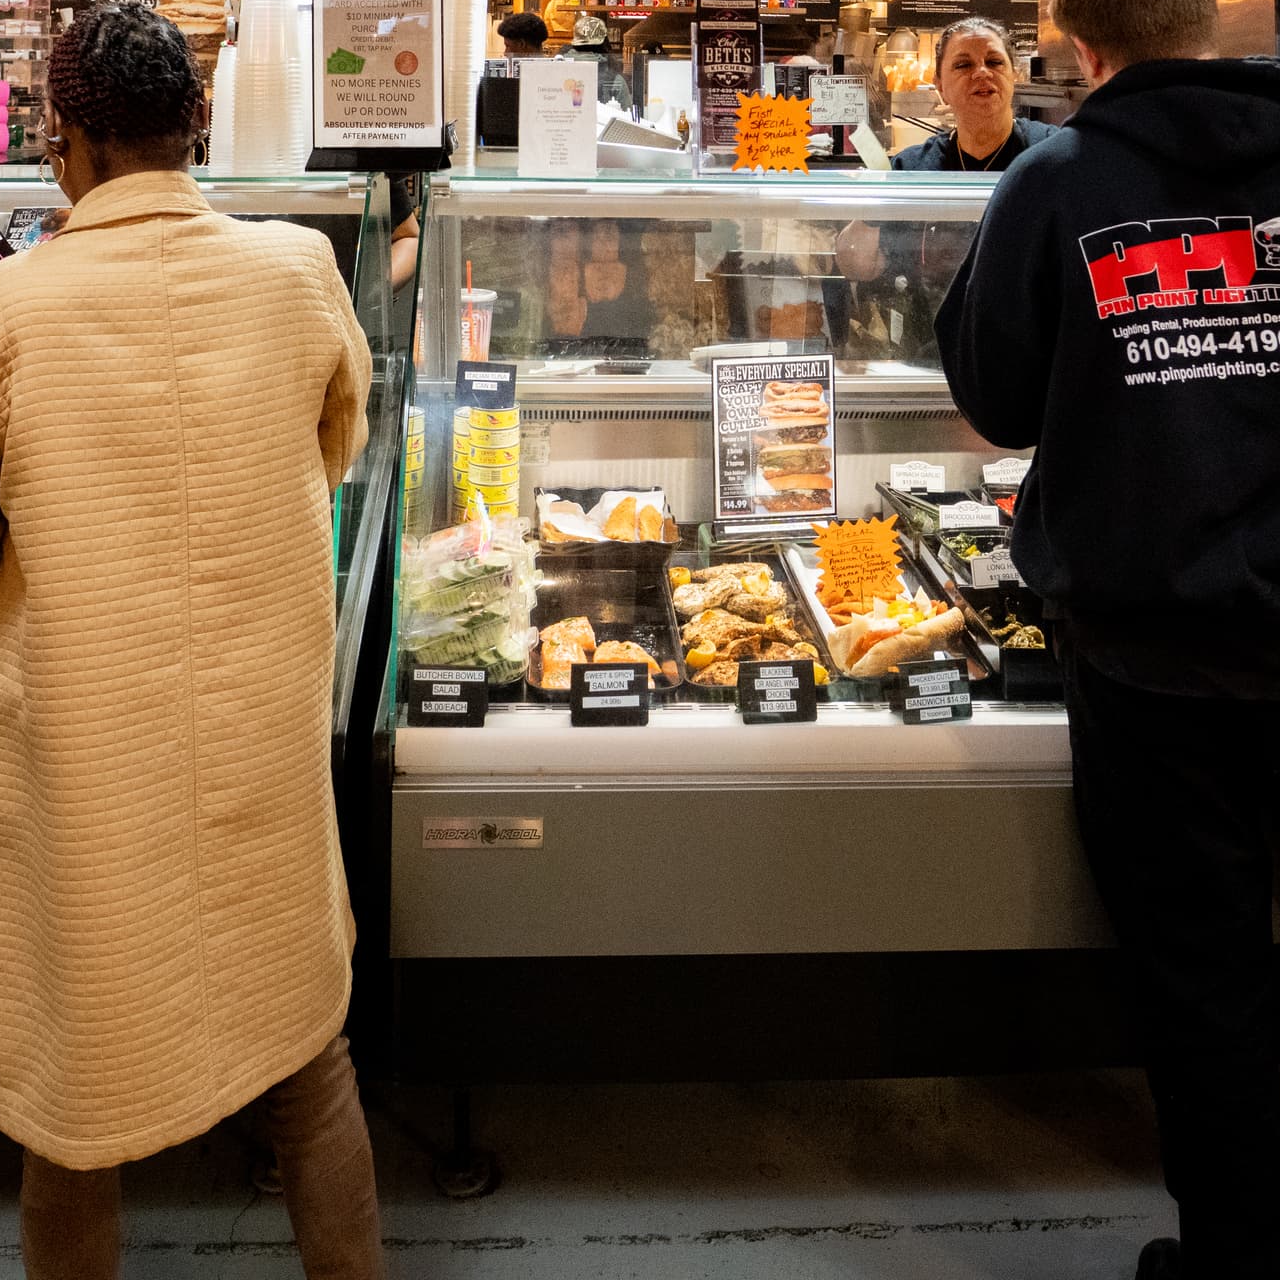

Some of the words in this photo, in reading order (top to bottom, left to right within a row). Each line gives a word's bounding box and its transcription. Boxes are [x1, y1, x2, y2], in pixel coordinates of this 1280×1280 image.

[328, 0, 353, 9] CARD
[354, 0, 400, 9] ACCEPTED
[401, 0, 423, 8] WITH
[346, 12, 361, 21] $10
[364, 12, 405, 21] MINIMUM
[706, 48, 752, 63] BETH'S
[331, 79, 345, 88] NO
[348, 79, 376, 88] MORE
[379, 79, 421, 88] PENNIES
[337, 93, 351, 102] WE
[353, 93, 376, 102] WILL
[379, 93, 415, 102] ROUND
[344, 107, 357, 116] UP
[360, 107, 374, 116] OR
[376, 107, 407, 116] DOWN
[324, 121, 373, 129] ABSOLUTLEY
[343, 132, 368, 140] AFTER
[368, 132, 406, 140] PAYMENT!
[1097, 297, 1135, 320] PIN
[1137, 290, 1198, 311] POINT
[1113, 321, 1150, 339] Lighting
[1152, 318, 1182, 334] Rental,
[1183, 315, 1240, 331] Production
[1241, 313, 1261, 325] and
[736, 362, 783, 380] EVERYDAY
[784, 360, 826, 379] SPECIAL!
[720, 381, 762, 396] CRAFT
[725, 394, 761, 407] YOUR
[726, 406, 759, 420] OWN
[719, 417, 769, 433] CUTLET
[987, 563, 1006, 571] LONG
[416, 672, 454, 680] BUTCHER
[456, 672, 484, 681] BOWLS
[433, 686, 460, 694] SALAD
[592, 681, 625, 690] SALMON
[907, 697, 946, 708] SANDWICH
[947, 694, 968, 705] $14.99
[425, 829, 477, 840] HYDRA
[500, 829, 541, 840] KOOL
